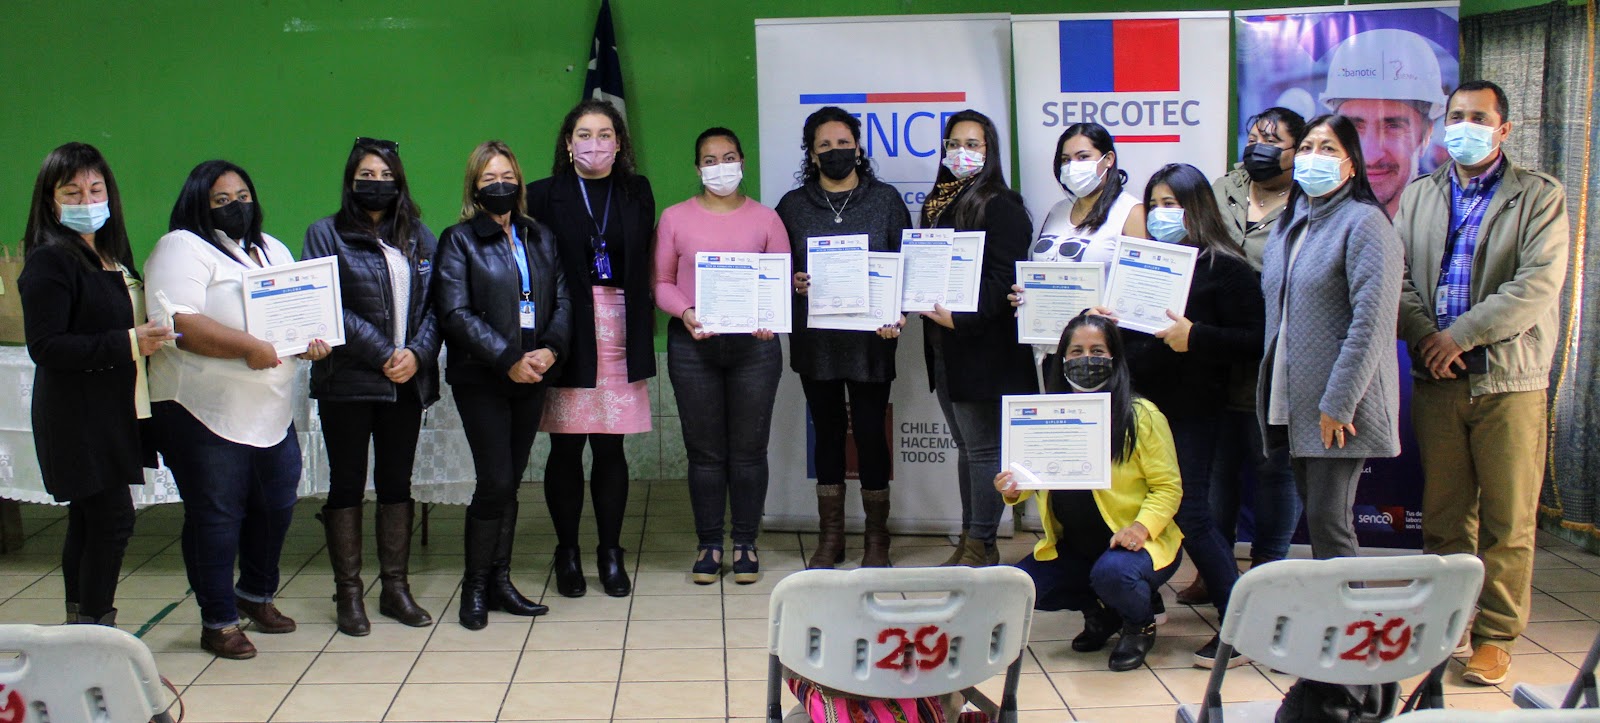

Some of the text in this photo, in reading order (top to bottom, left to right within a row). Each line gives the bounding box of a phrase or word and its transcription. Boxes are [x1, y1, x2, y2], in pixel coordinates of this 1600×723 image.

[1042, 100, 1200, 127] SERCOTEC
[901, 422, 951, 435] CHILE L
[901, 437, 959, 449] HACEMO
[901, 451, 946, 463] TODOS
[1340, 614, 1411, 661] 29
[876, 626, 949, 671] 29
